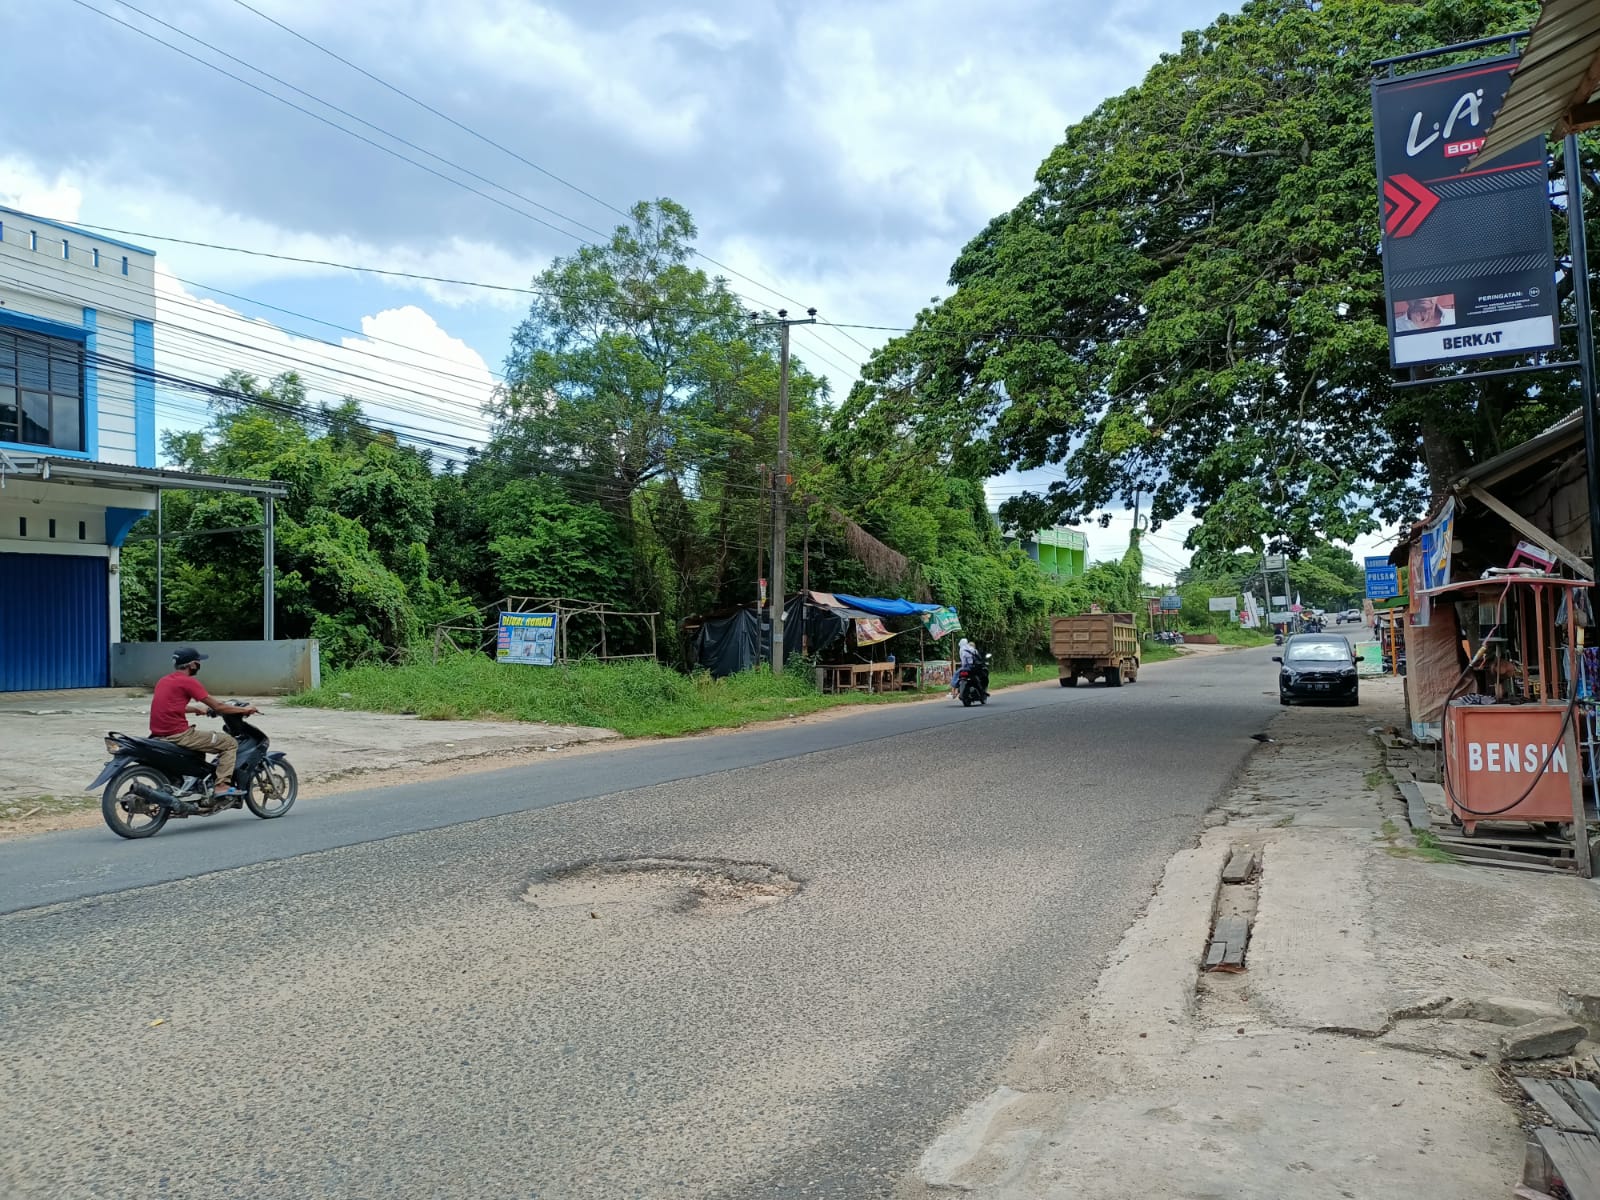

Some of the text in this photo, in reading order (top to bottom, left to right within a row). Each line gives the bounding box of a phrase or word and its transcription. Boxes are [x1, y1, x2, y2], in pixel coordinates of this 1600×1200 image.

[1447, 140, 1486, 154] BOL
[1443, 331, 1503, 350] BERKAT
[1468, 742, 1568, 773] BENSIN
